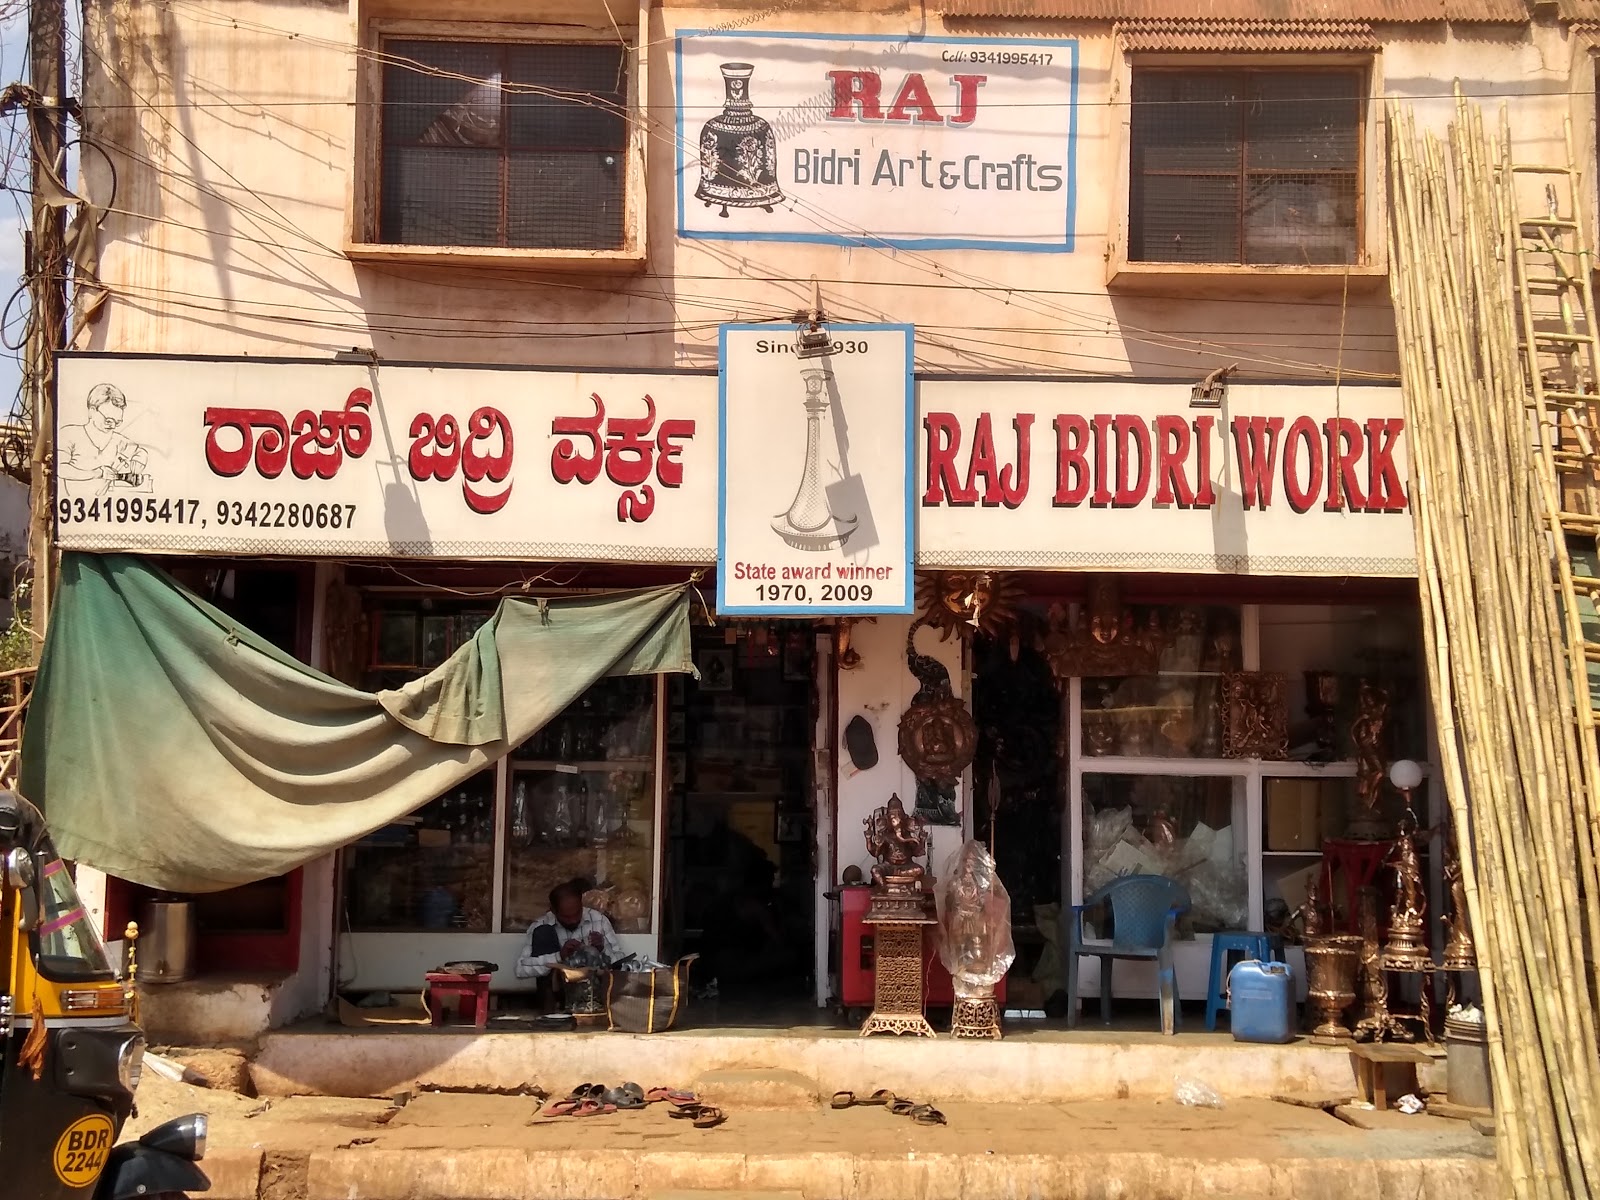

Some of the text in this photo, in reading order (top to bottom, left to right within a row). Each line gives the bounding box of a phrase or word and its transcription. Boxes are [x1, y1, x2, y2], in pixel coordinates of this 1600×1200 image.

[942, 51, 1053, 66] Cell: 9341995417
[826, 70, 987, 127] RAJ
[794, 148, 860, 185] Bidri
[756, 340, 868, 354] Sin 930
[203, 387, 373, 481] ರಾಜ್
[407, 405, 514, 515] ಬಿದ್ರಿ
[922, 412, 1035, 507] RAJ
[1052, 413, 1216, 509] BIDRI
[59, 497, 357, 529] 9341995417, 9342280687
[734, 561, 893, 581] State award winner
[755, 584, 873, 604] 1970, 2009
[68, 1129, 109, 1151] BDR
[63, 1151, 104, 1173] 2244
